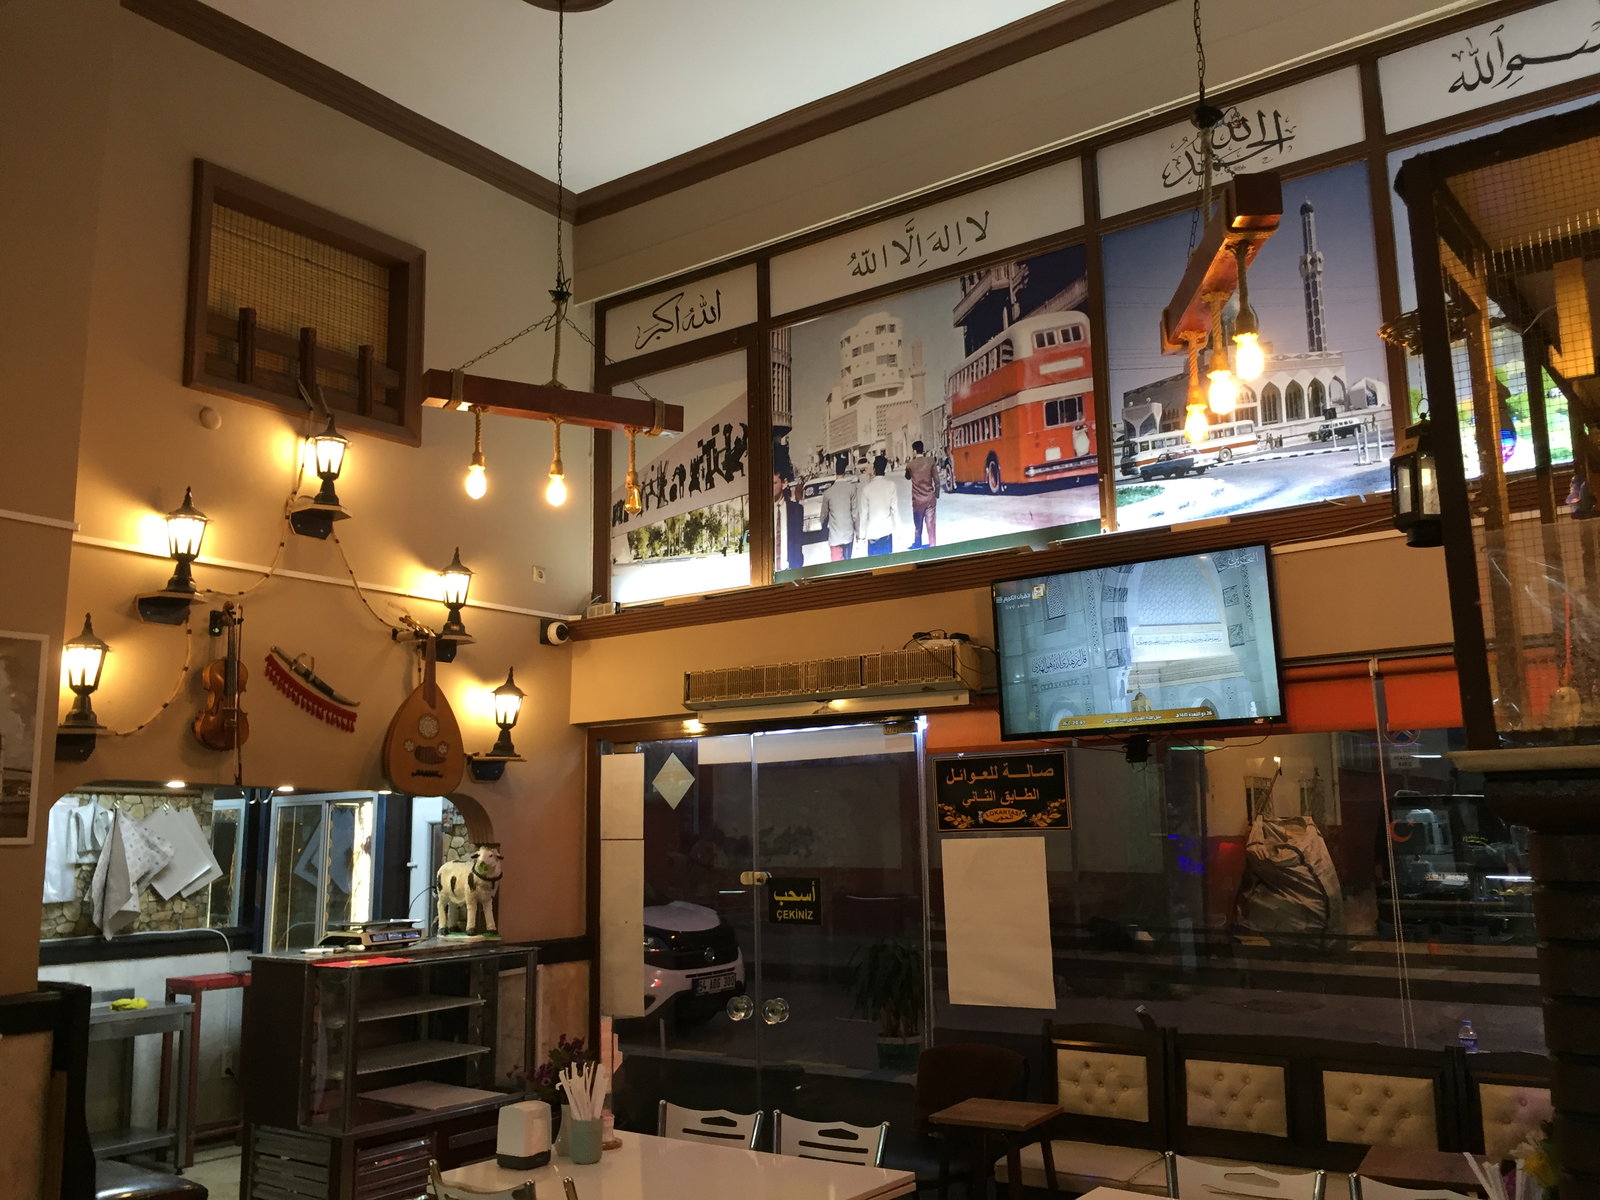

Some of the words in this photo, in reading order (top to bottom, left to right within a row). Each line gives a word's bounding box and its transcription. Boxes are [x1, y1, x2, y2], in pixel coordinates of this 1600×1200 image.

[1002, 762, 1055, 779] صالة
[962, 789, 996, 807] الثاني
[1000, 787, 1040, 806] الطابق
[776, 908, 814, 921] ÇEKİNİZ
